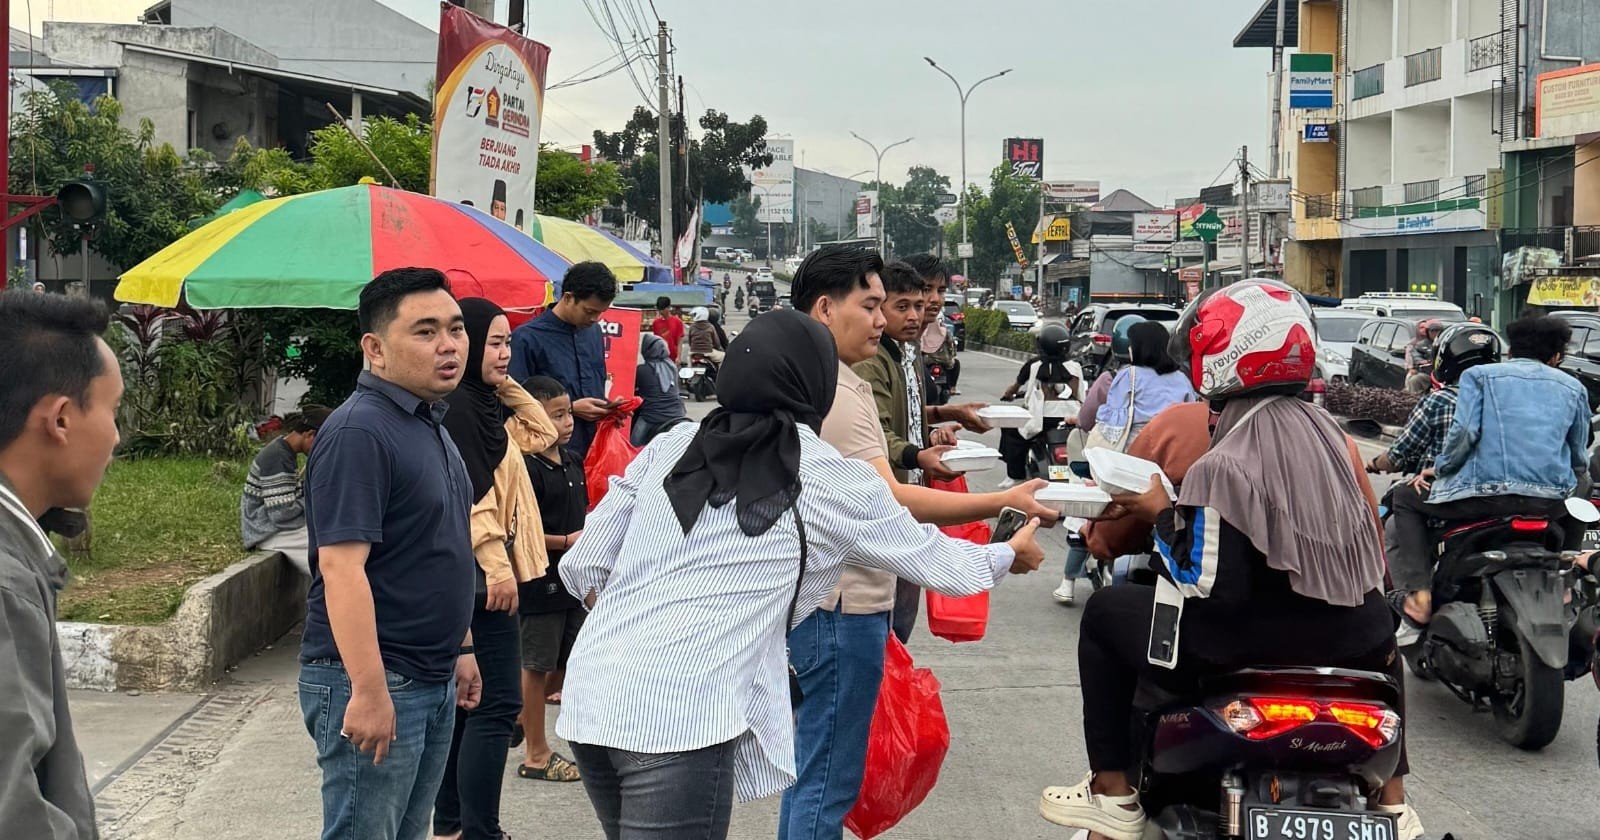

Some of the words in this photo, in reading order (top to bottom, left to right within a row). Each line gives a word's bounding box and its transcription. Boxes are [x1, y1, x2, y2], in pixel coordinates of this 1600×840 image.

[485, 51, 525, 90] Dirgahayu
[1291, 76, 1332, 85] FamilyMart
[502, 93, 525, 112] PARTAI
[502, 109, 530, 129] GERINDRA
[480, 137, 517, 157] BERJUANG
[767, 146, 785, 154] PACE
[1012, 140, 1038, 161] Hi
[479, 153, 501, 169] TIADA
[500, 158, 521, 175] AKHIR
[598, 318, 619, 334] ta
[1256, 815, 1269, 838] B
[1281, 816, 1334, 840] 4979
